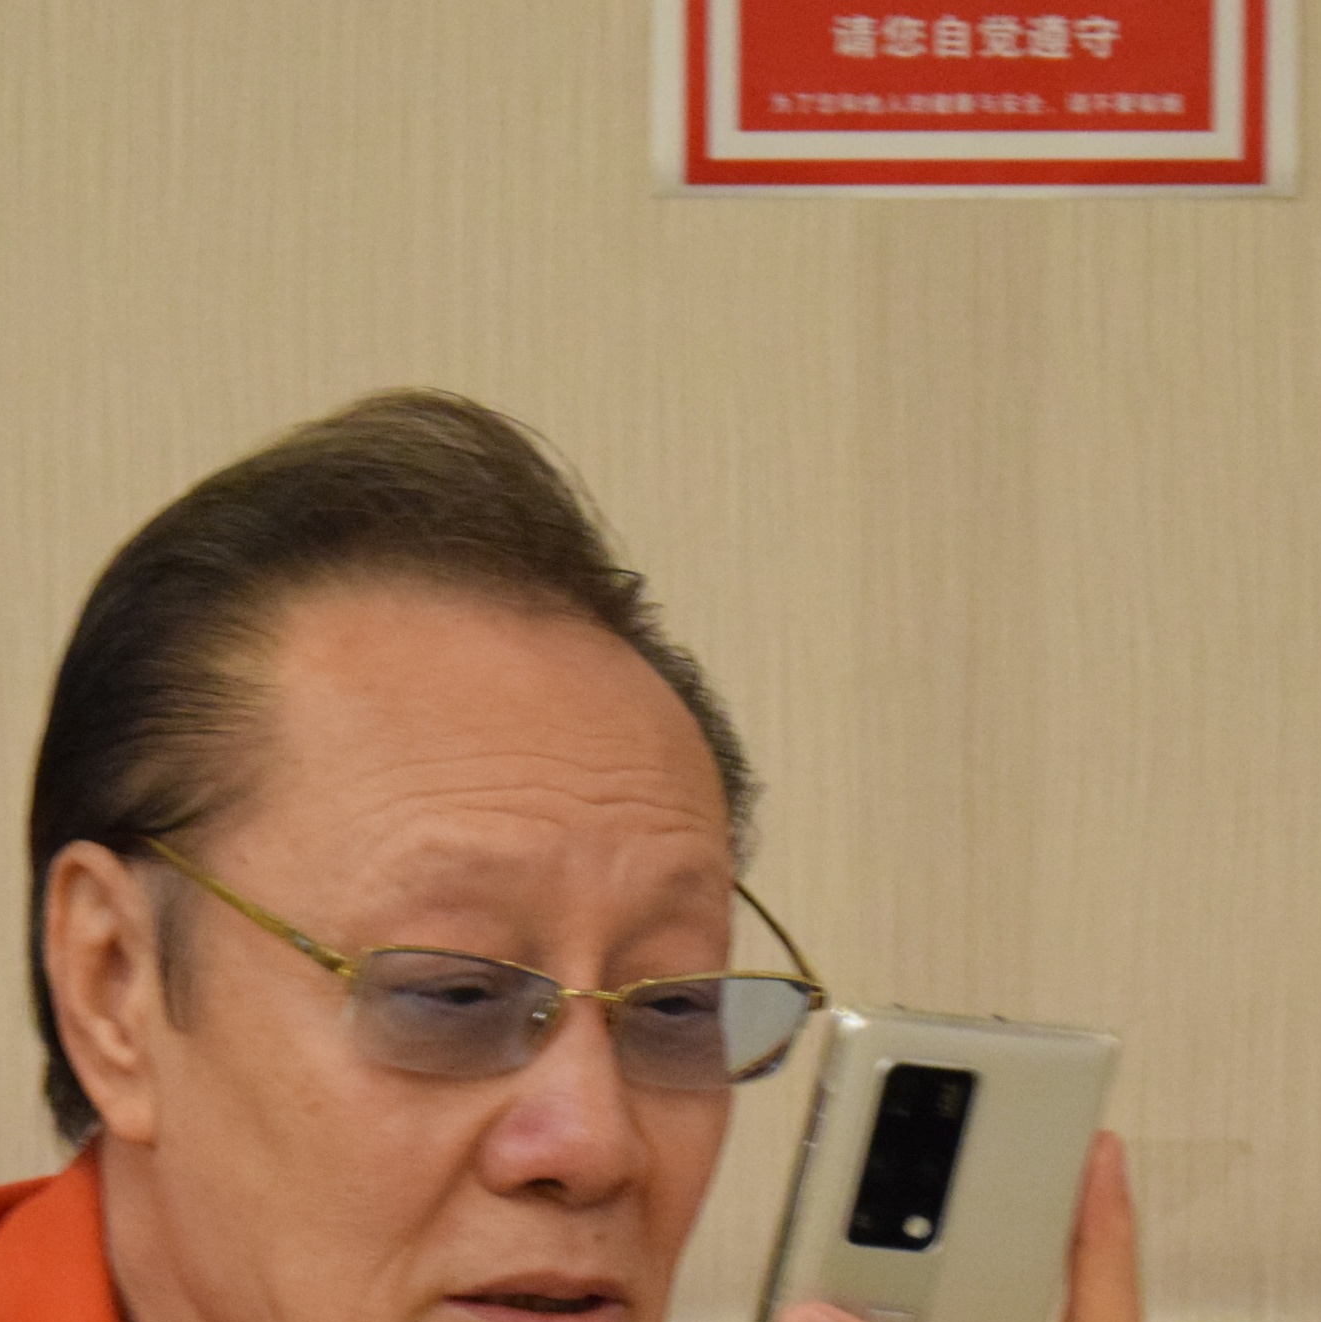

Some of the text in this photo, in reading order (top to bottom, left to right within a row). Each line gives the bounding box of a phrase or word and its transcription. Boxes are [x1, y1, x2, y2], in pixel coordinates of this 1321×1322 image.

[831, 14, 1121, 59] 请您自觉遵守
